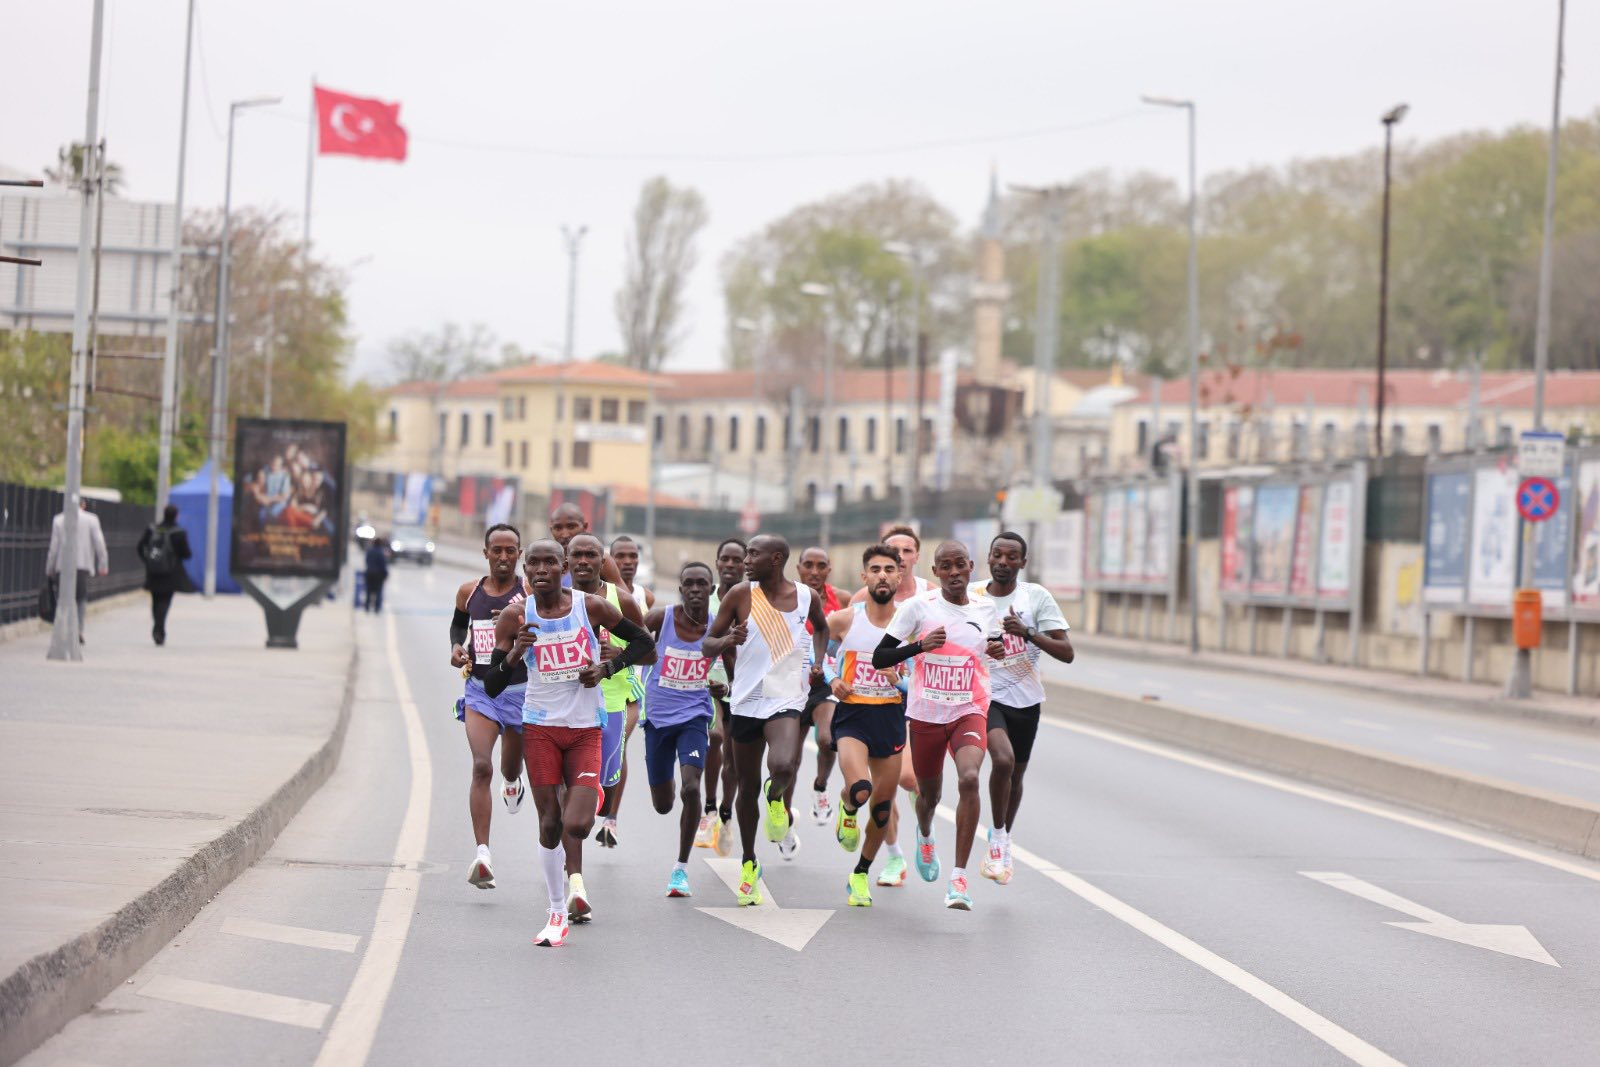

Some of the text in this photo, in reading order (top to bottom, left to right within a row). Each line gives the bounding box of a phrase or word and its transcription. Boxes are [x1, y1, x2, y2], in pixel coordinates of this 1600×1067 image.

[539, 639, 592, 671] ALEX
[665, 657, 706, 680] SILAS
[924, 664, 975, 691] MATHEW
